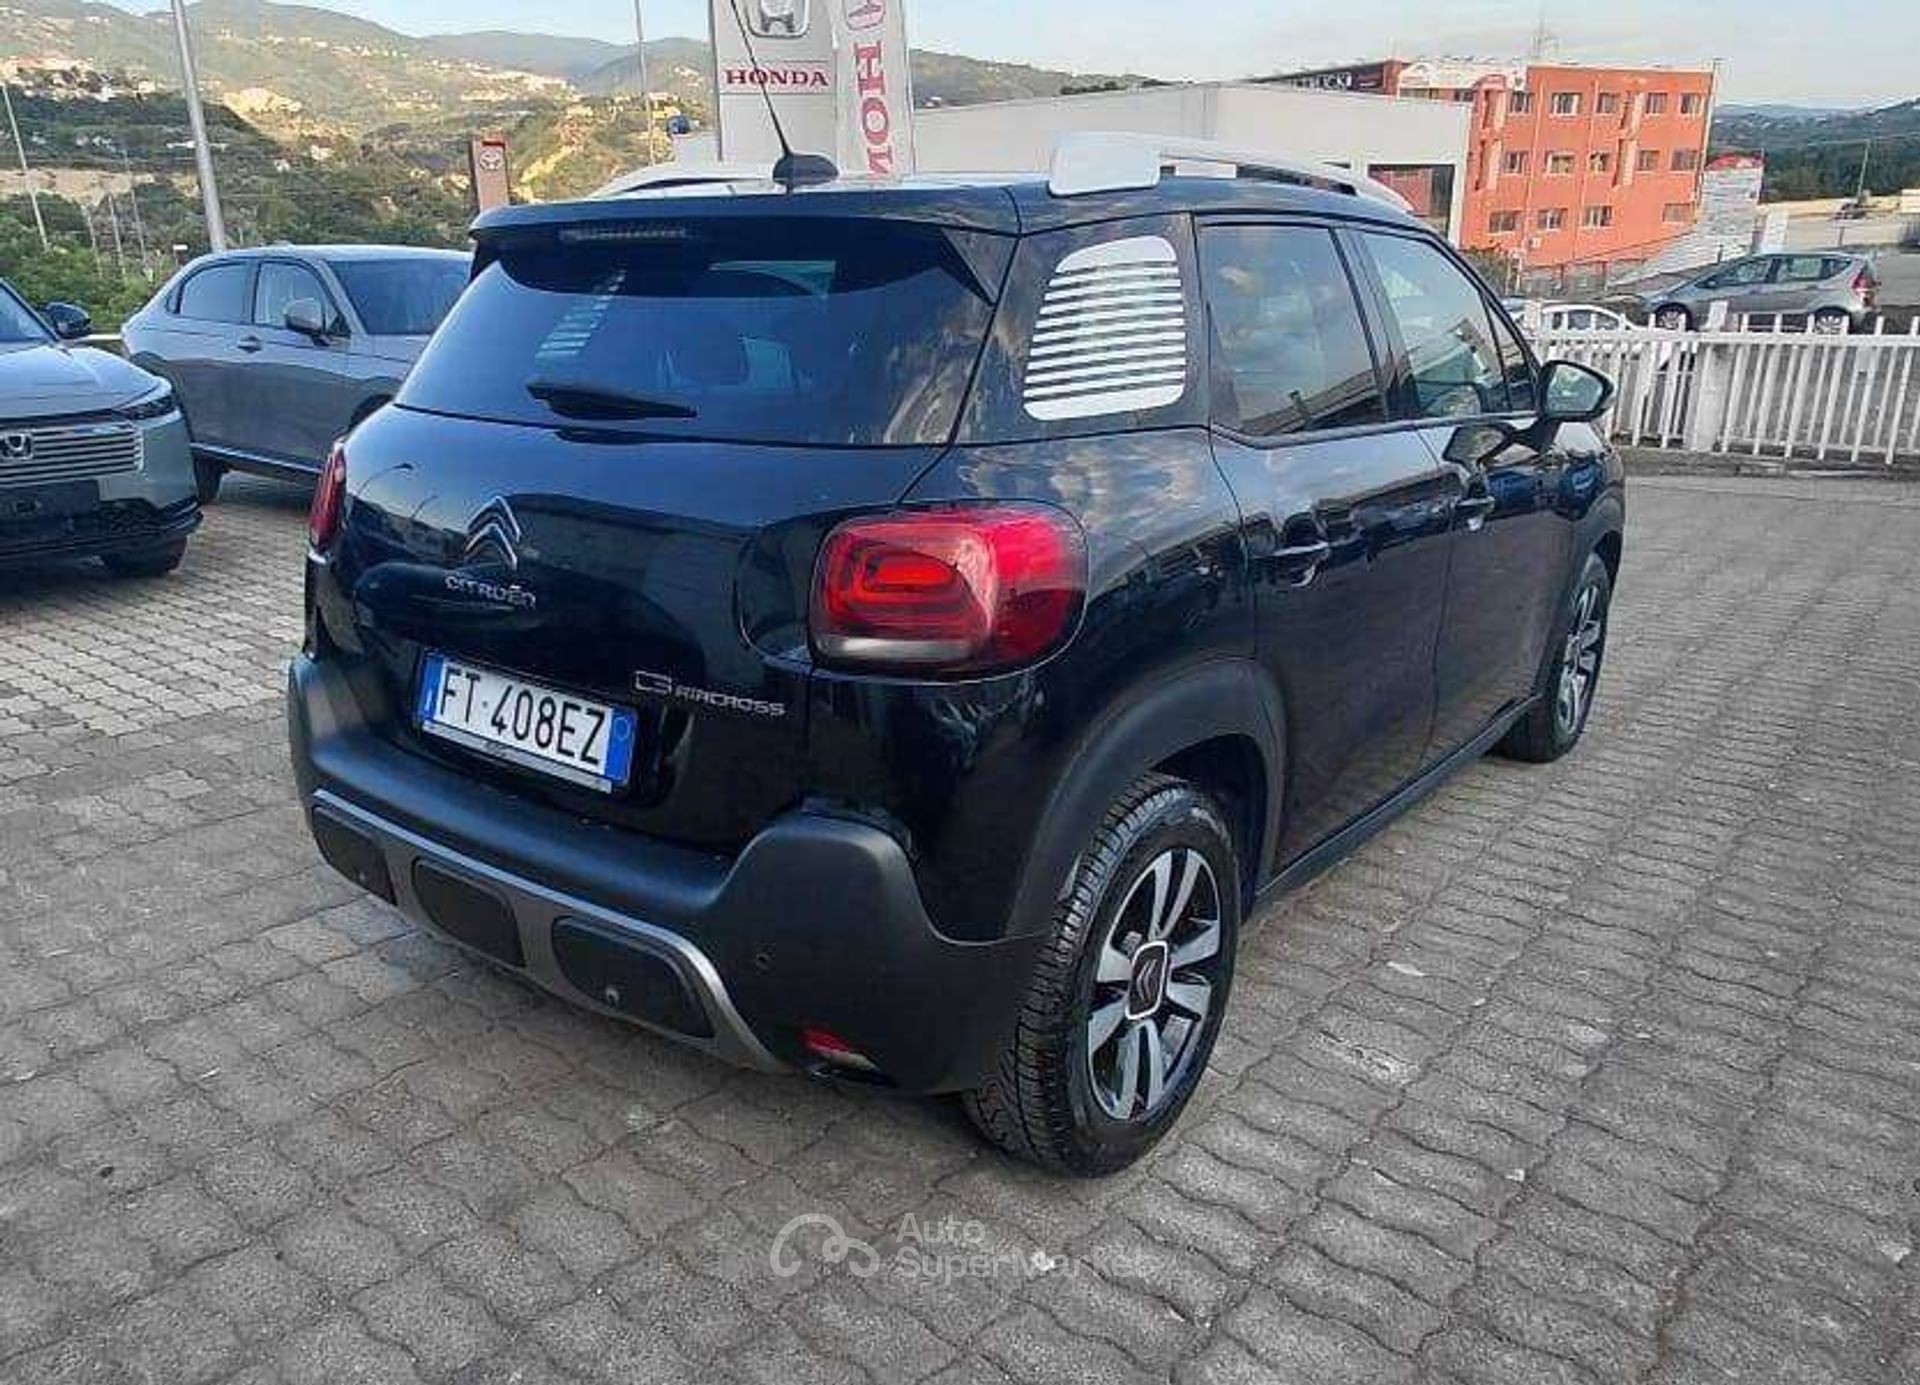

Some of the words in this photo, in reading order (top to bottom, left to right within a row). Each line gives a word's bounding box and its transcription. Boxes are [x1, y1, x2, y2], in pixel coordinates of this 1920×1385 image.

[725, 69, 829, 87] HONDA
[440, 665, 481, 723] FT
[491, 684, 606, 766] 408EZ
[675, 685, 786, 717] AIRCROSS
